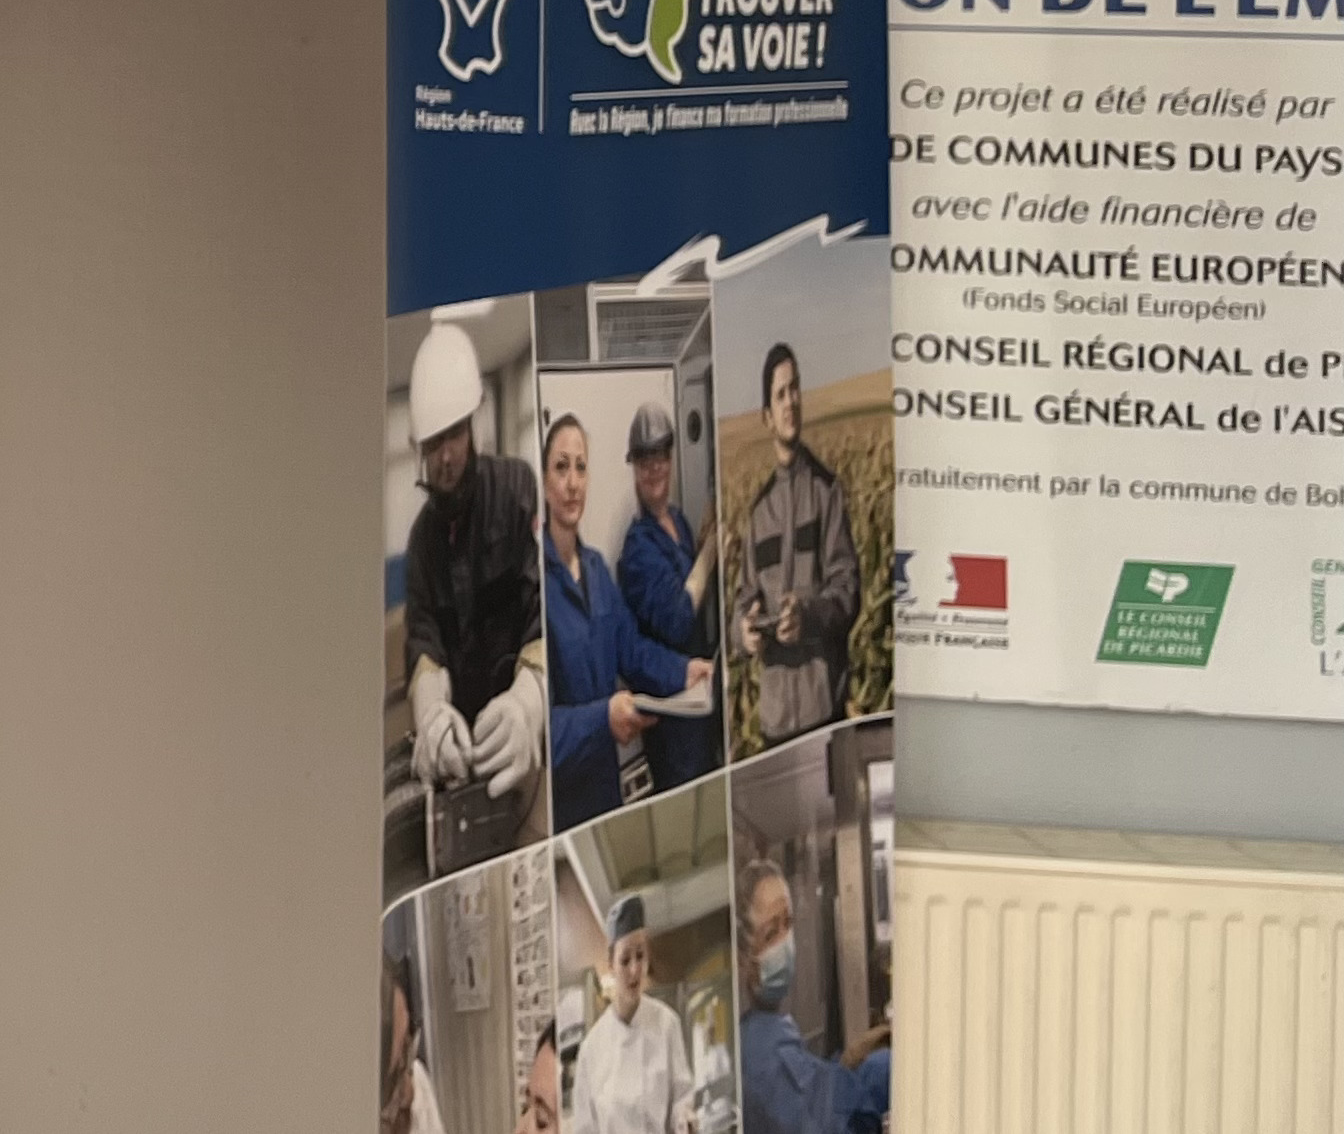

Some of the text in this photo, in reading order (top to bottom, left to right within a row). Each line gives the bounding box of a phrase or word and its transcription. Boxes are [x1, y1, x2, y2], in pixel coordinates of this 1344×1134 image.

[697, 21, 826, 74] SA VOIE !
[416, 108, 524, 134] Hauts-de-France
[901, 79, 1335, 125] Ce projet a été réalisé par
[889, 134, 1342, 181] DE COMMUNES DU PAYS
[912, 192, 1316, 231] avec l'aide financière de
[890, 243, 1344, 287] OMMUNAUTÉ EUROPÉEN
[963, 287, 1266, 323] (Fonds Social Européen)
[891, 332, 1344, 379] CONSEIL RÉGIONAL de P
[893, 387, 1344, 436] ONSEIL GÉNÉRAL de l'AIS
[896, 466, 1042, 493] ratuitement
[1049, 476, 1091, 498] par
[1099, 474, 1120, 498] la
[1129, 480, 1257, 504] commune
[1265, 482, 1297, 506] de
